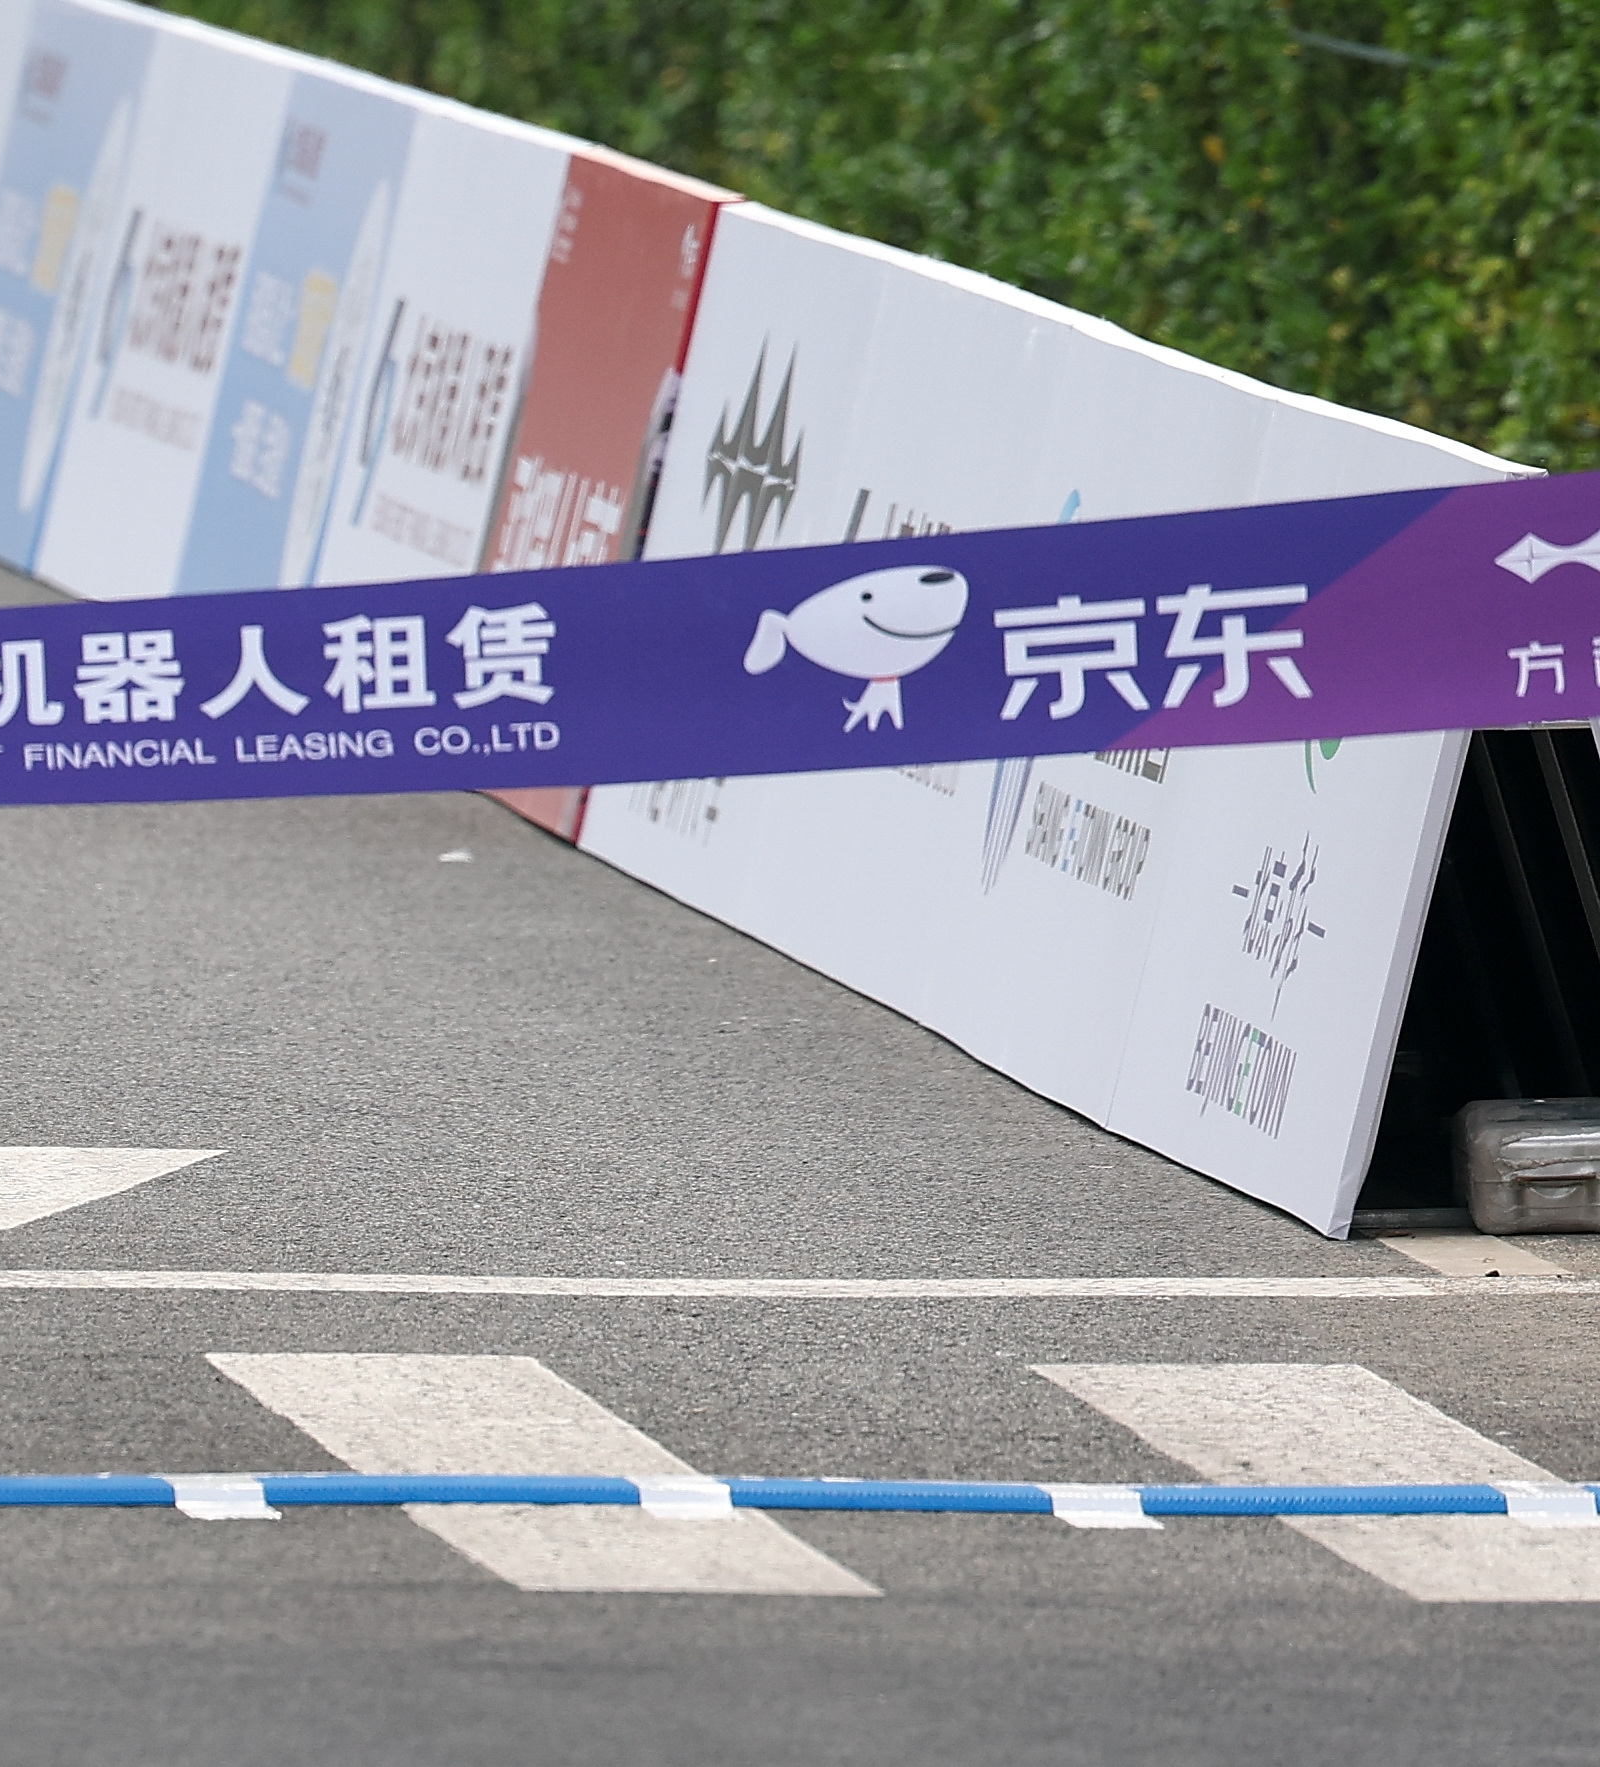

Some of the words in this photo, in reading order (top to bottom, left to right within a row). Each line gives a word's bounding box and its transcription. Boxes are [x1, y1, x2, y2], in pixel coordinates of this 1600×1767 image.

[993, 584, 1315, 721] 京东
[24, 739, 215, 769] FINANCIAL
[236, 730, 393, 762] LEASING
[415, 722, 559, 755] CO.,LTD
